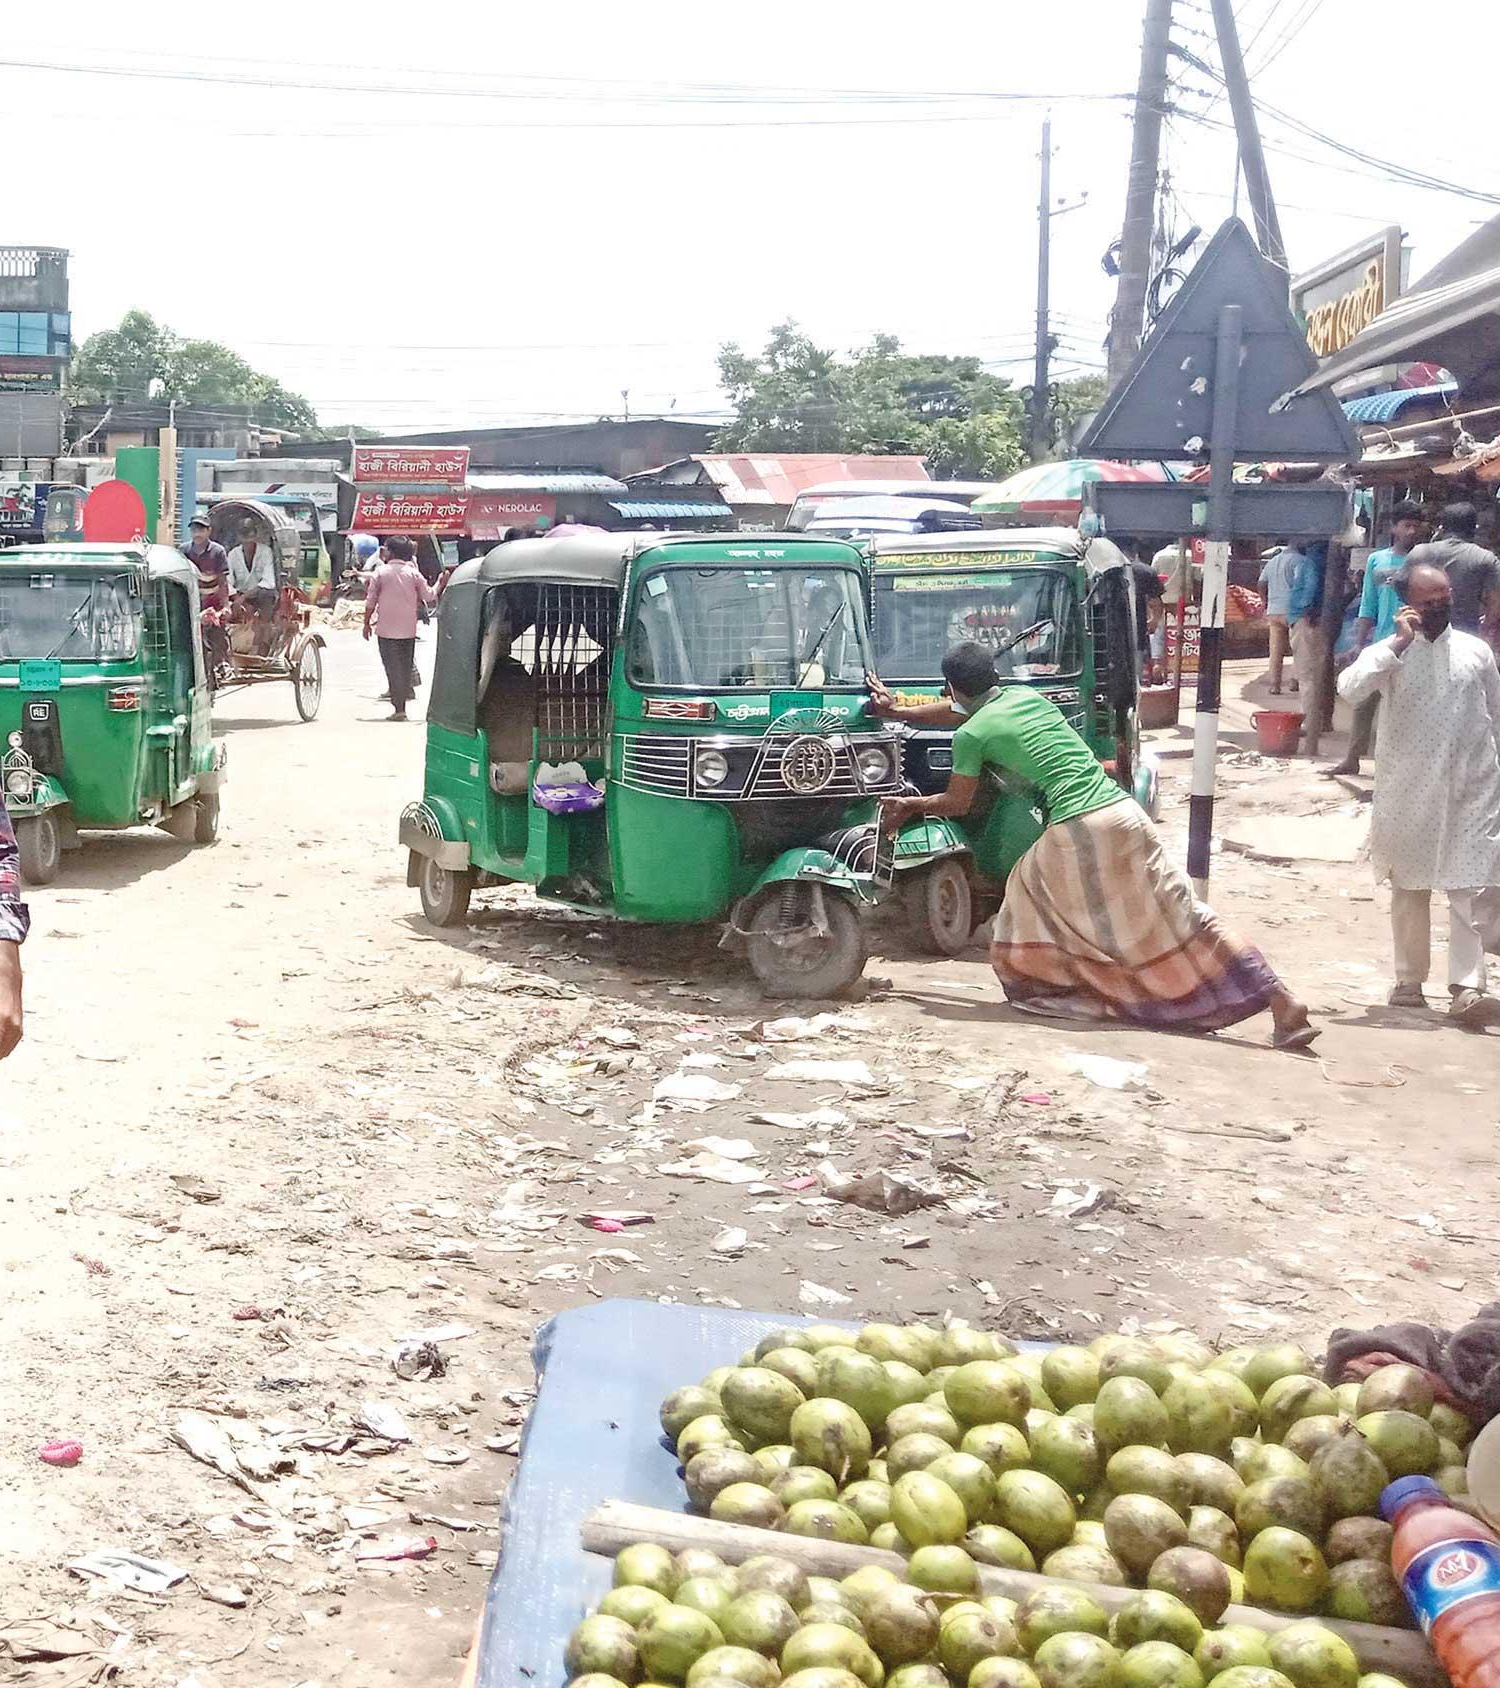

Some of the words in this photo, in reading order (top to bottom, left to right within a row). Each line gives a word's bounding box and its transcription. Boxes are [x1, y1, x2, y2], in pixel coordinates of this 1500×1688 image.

[358, 458, 384, 472] হাজী
[435, 461, 464, 473] হাউস
[361, 501, 387, 517] হাজী
[436, 503, 468, 517] হাউস
[499, 504, 542, 514] NEROLAC
